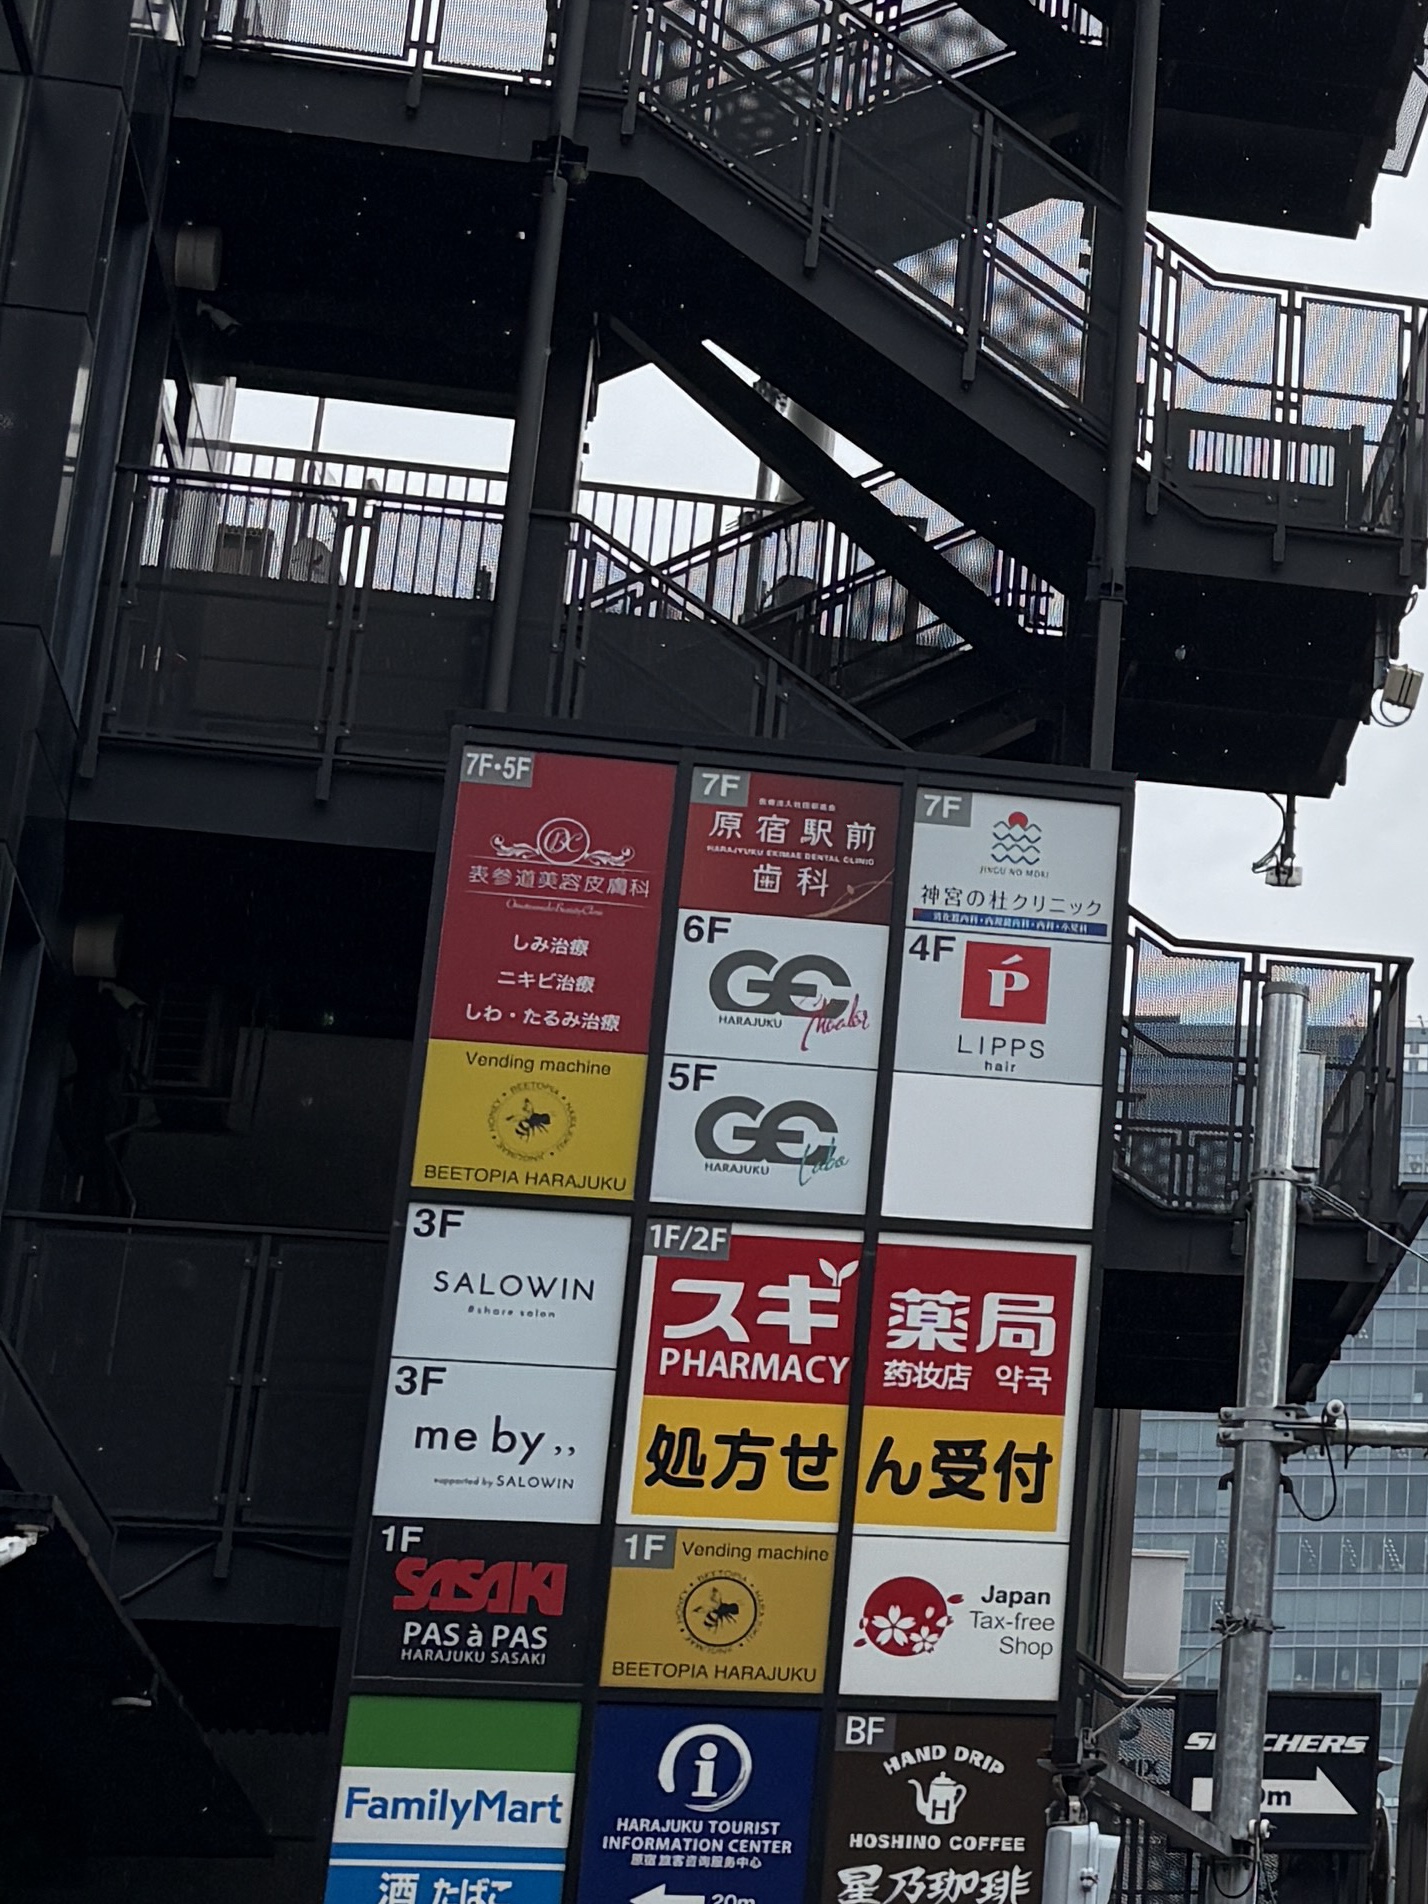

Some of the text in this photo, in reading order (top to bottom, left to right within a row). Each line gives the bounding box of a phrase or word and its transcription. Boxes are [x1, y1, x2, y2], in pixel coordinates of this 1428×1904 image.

[702, 773, 741, 797] 7F
[924, 795, 962, 818] 7F
[709, 811, 876, 852] 原宿駅前
[805, 853, 840, 863] DENTAL
[843, 856, 874, 866] CLINIC
[980, 865, 1049, 878] JINGU NO MORI
[469, 865, 649, 897] 表参道美容皮膚科
[753, 864, 829, 897] 歯科
[921, 885, 1101, 917] 神宮の杜クリニック
[684, 915, 731, 943] 6F
[514, 934, 589, 957] しみ治療
[909, 935, 956, 962] 4F
[497, 970, 595, 993] ニキビ治療
[466, 1003, 620, 1032] しわ・たるみ治療
[719, 1015, 782, 1028] HARAJUKU
[958, 1035, 1045, 1059] LIPPS
[466, 1052, 611, 1075] Vending machine
[984, 1061, 1016, 1072] hair
[668, 1063, 717, 1091] 5F
[425, 1165, 626, 1191] BEETOPIA HARAJUKU
[705, 1162, 770, 1175] HARAJUKU
[414, 1209, 464, 1238] 3F
[651, 1224, 727, 1252] 1F/2F
[433, 1270, 595, 1301] SALOWIN
[520, 1309, 556, 1318] salon
[664, 1270, 1055, 1358] スギ薬局
[660, 1347, 850, 1384] PHARMACY
[884, 1361, 973, 1391] 药妆店
[395, 1366, 446, 1396] 3F
[996, 1364, 1051, 1395] 약국
[415, 1425, 477, 1451] me
[645, 1424, 1053, 1504] 処方せん受付
[496, 1475, 573, 1489] SALOWIN
[381, 1526, 423, 1552] 1F
[625, 1534, 666, 1560] 1F
[682, 1542, 829, 1561] Vending machine
[981, 1585, 1051, 1606] Japan
[969, 1611, 1055, 1632] Tax-free
[403, 1622, 548, 1649] PAS à PAS
[1000, 1637, 1054, 1658] Shop
[401, 1648, 546, 1665] HARAJUKU SASAKI
[612, 1661, 817, 1682] BEETOPIA HARAJUKU
[846, 1716, 885, 1745] BF
[1184, 1732, 1369, 1754] SCHERS
[883, 1744, 1005, 1776] HAND DRIP
[344, 1787, 562, 1830] FamilyMart
[617, 1818, 780, 1835] HARAJUKU TOURIST
[602, 1836, 792, 1854] INFORMATION CENTER
[849, 1833, 1025, 1852] HOSHINO COFFEE
